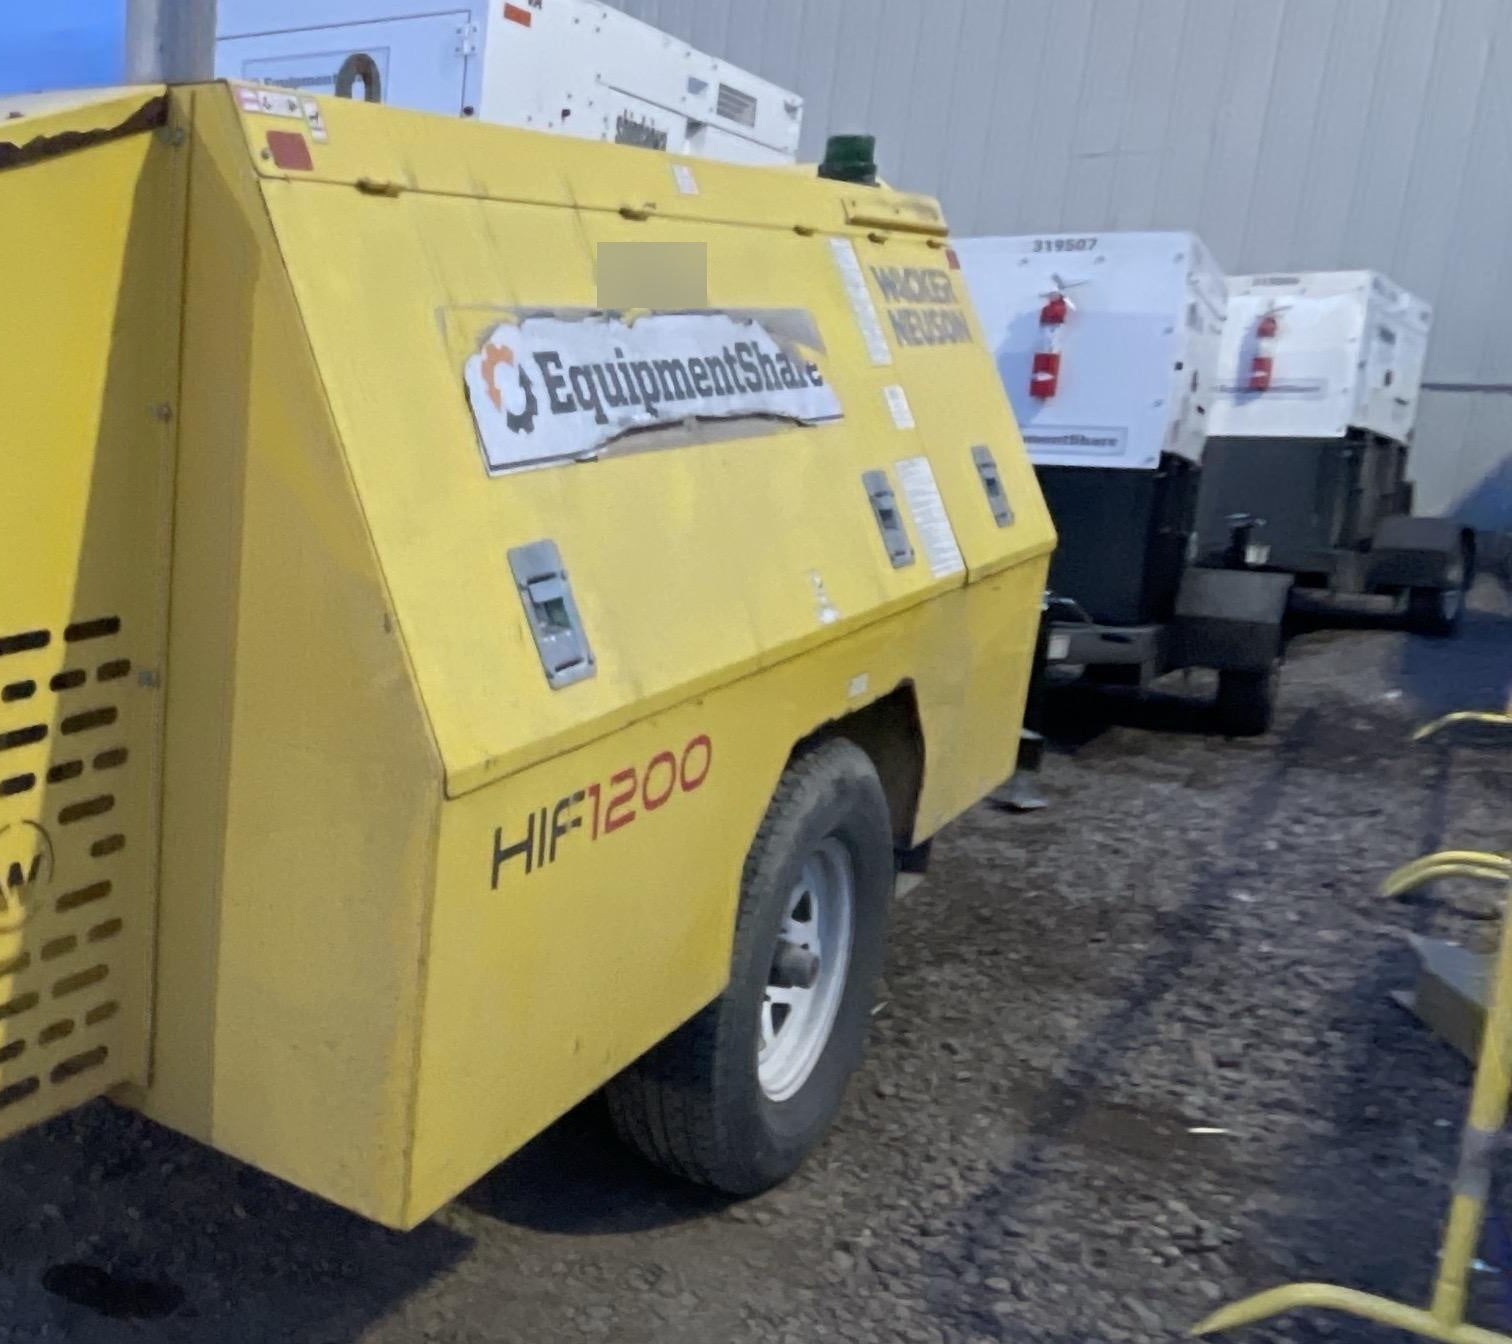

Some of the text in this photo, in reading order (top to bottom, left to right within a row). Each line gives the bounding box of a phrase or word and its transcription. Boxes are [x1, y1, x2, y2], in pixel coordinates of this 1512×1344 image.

[870, 265, 958, 304] WACKER
[887, 308, 974, 348] NEUSON
[490, 733, 713, 892] HIF1200
